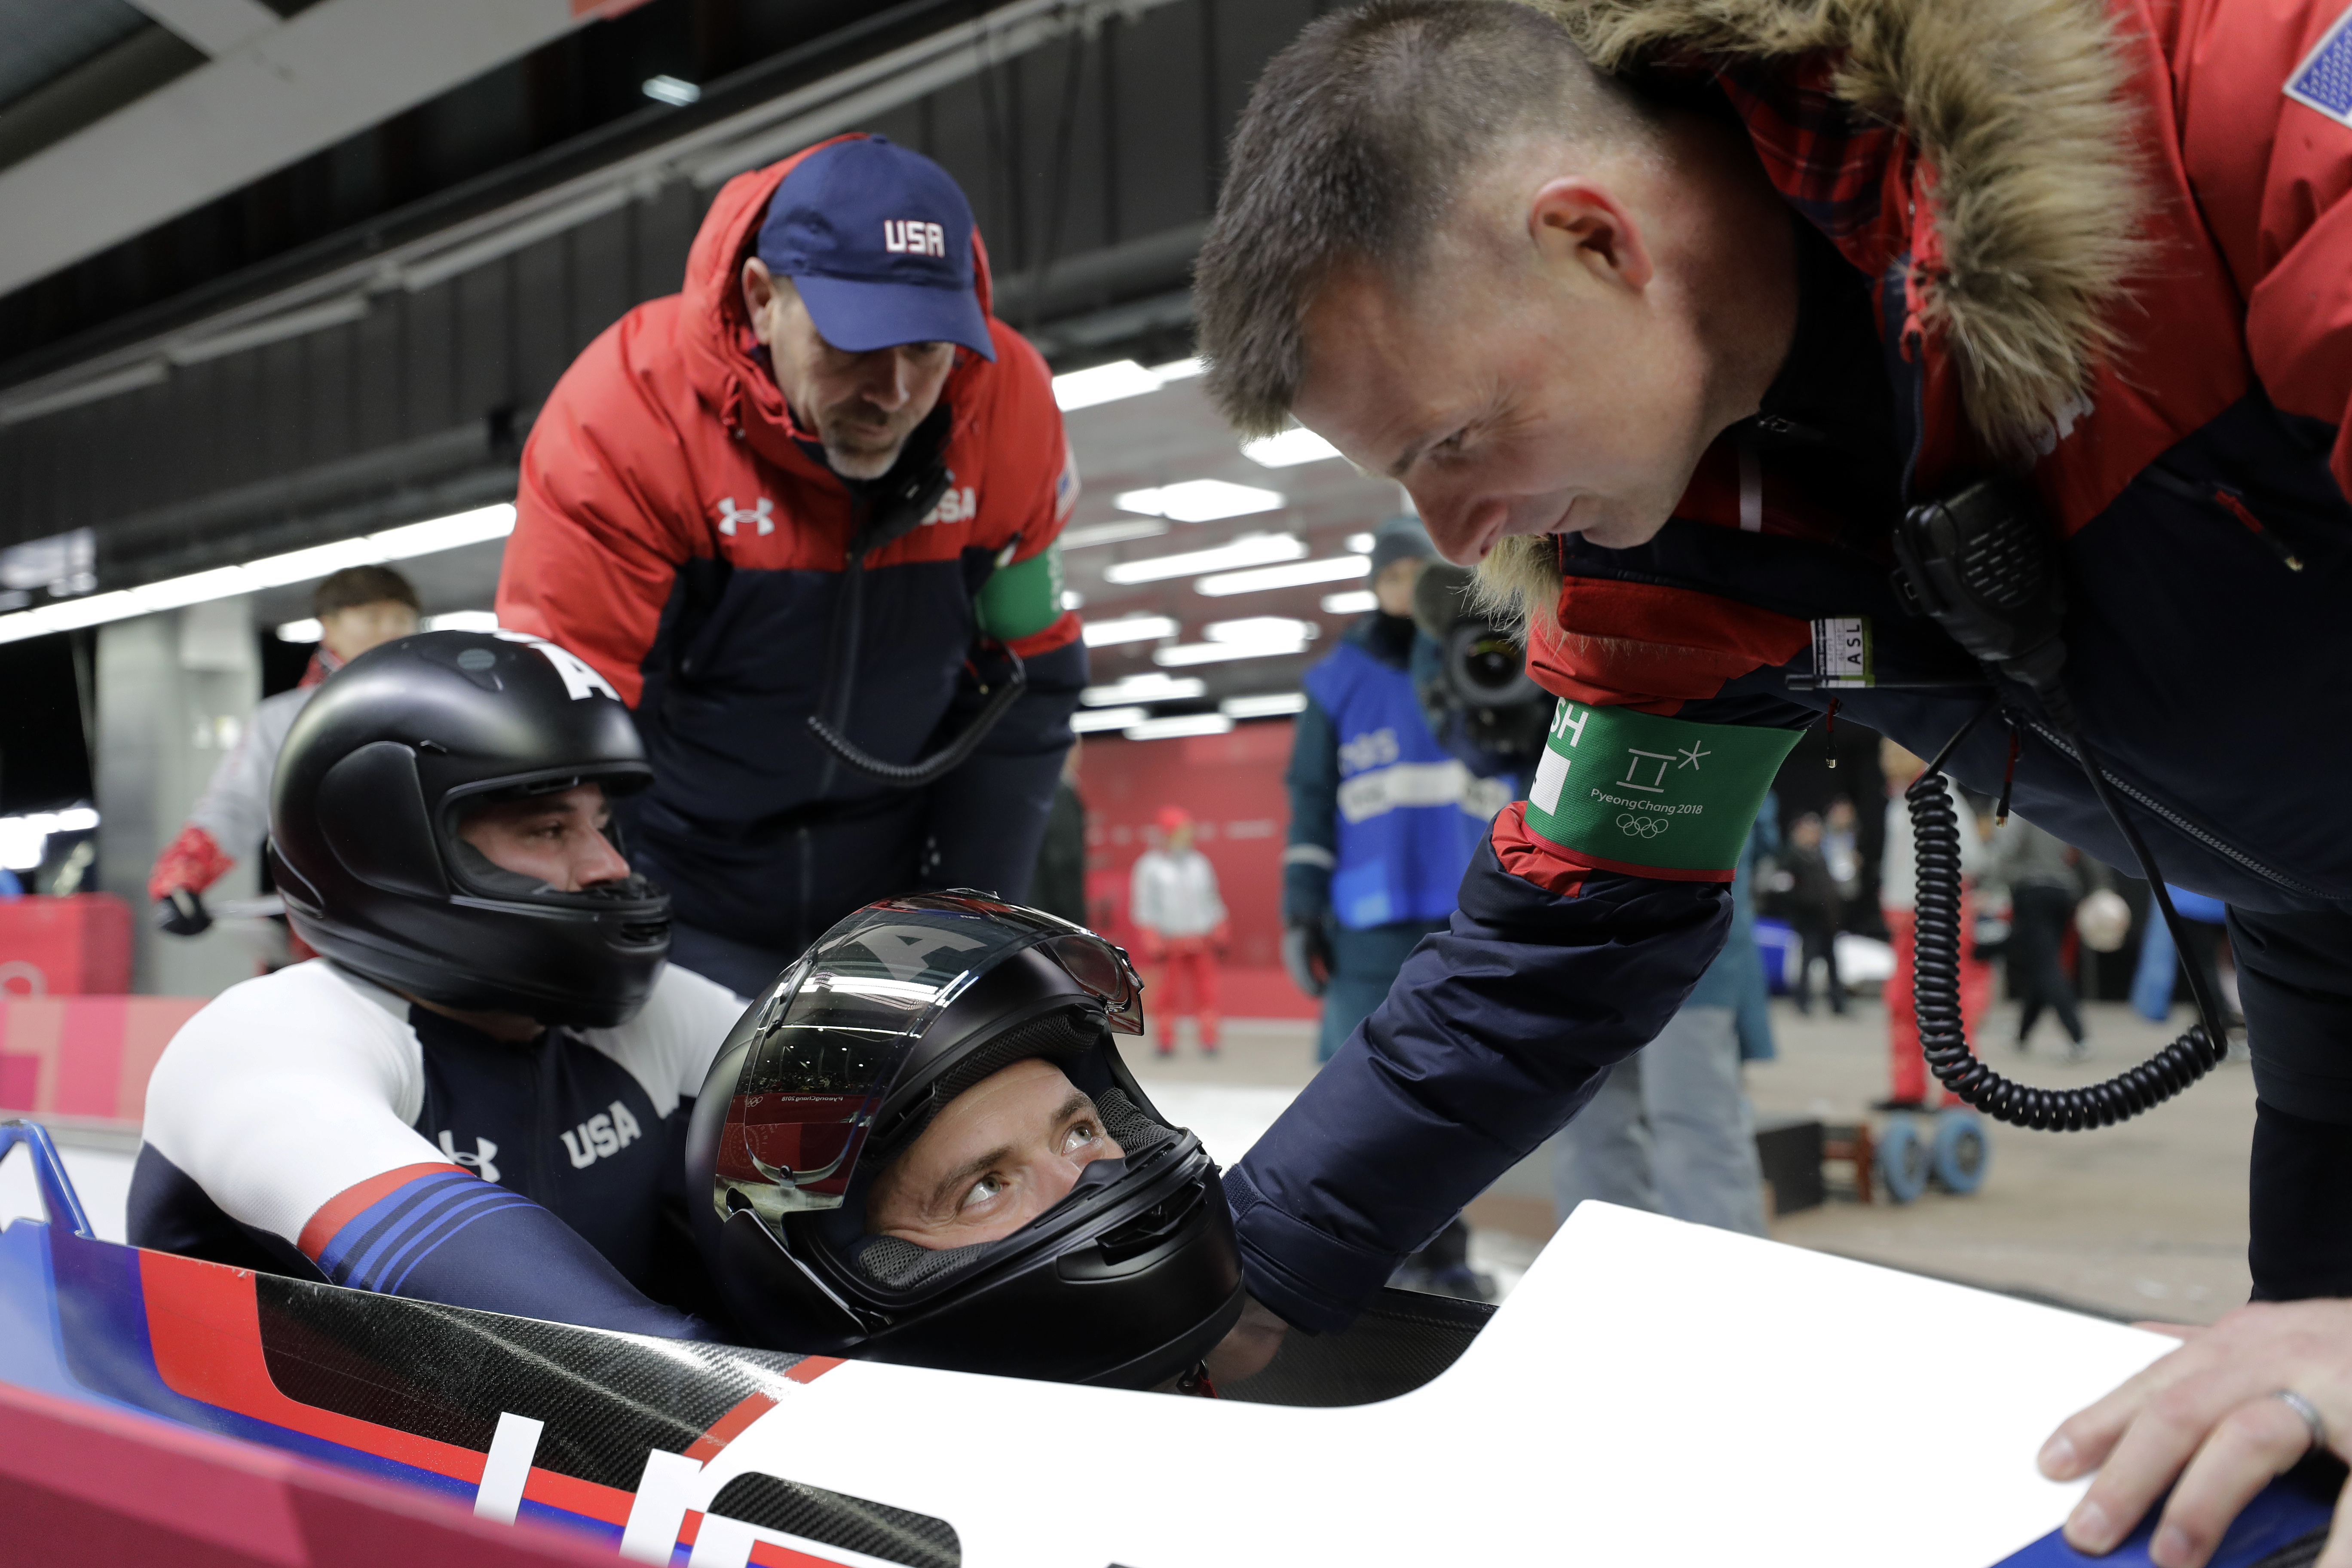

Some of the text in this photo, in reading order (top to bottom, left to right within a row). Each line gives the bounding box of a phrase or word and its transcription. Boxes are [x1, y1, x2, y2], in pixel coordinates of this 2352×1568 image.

[884, 220, 945, 258] USA
[1847, 625, 1861, 664] ASL
[1591, 788, 1703, 815] PyeongChang 2018
[560, 1100, 641, 1170] USA
